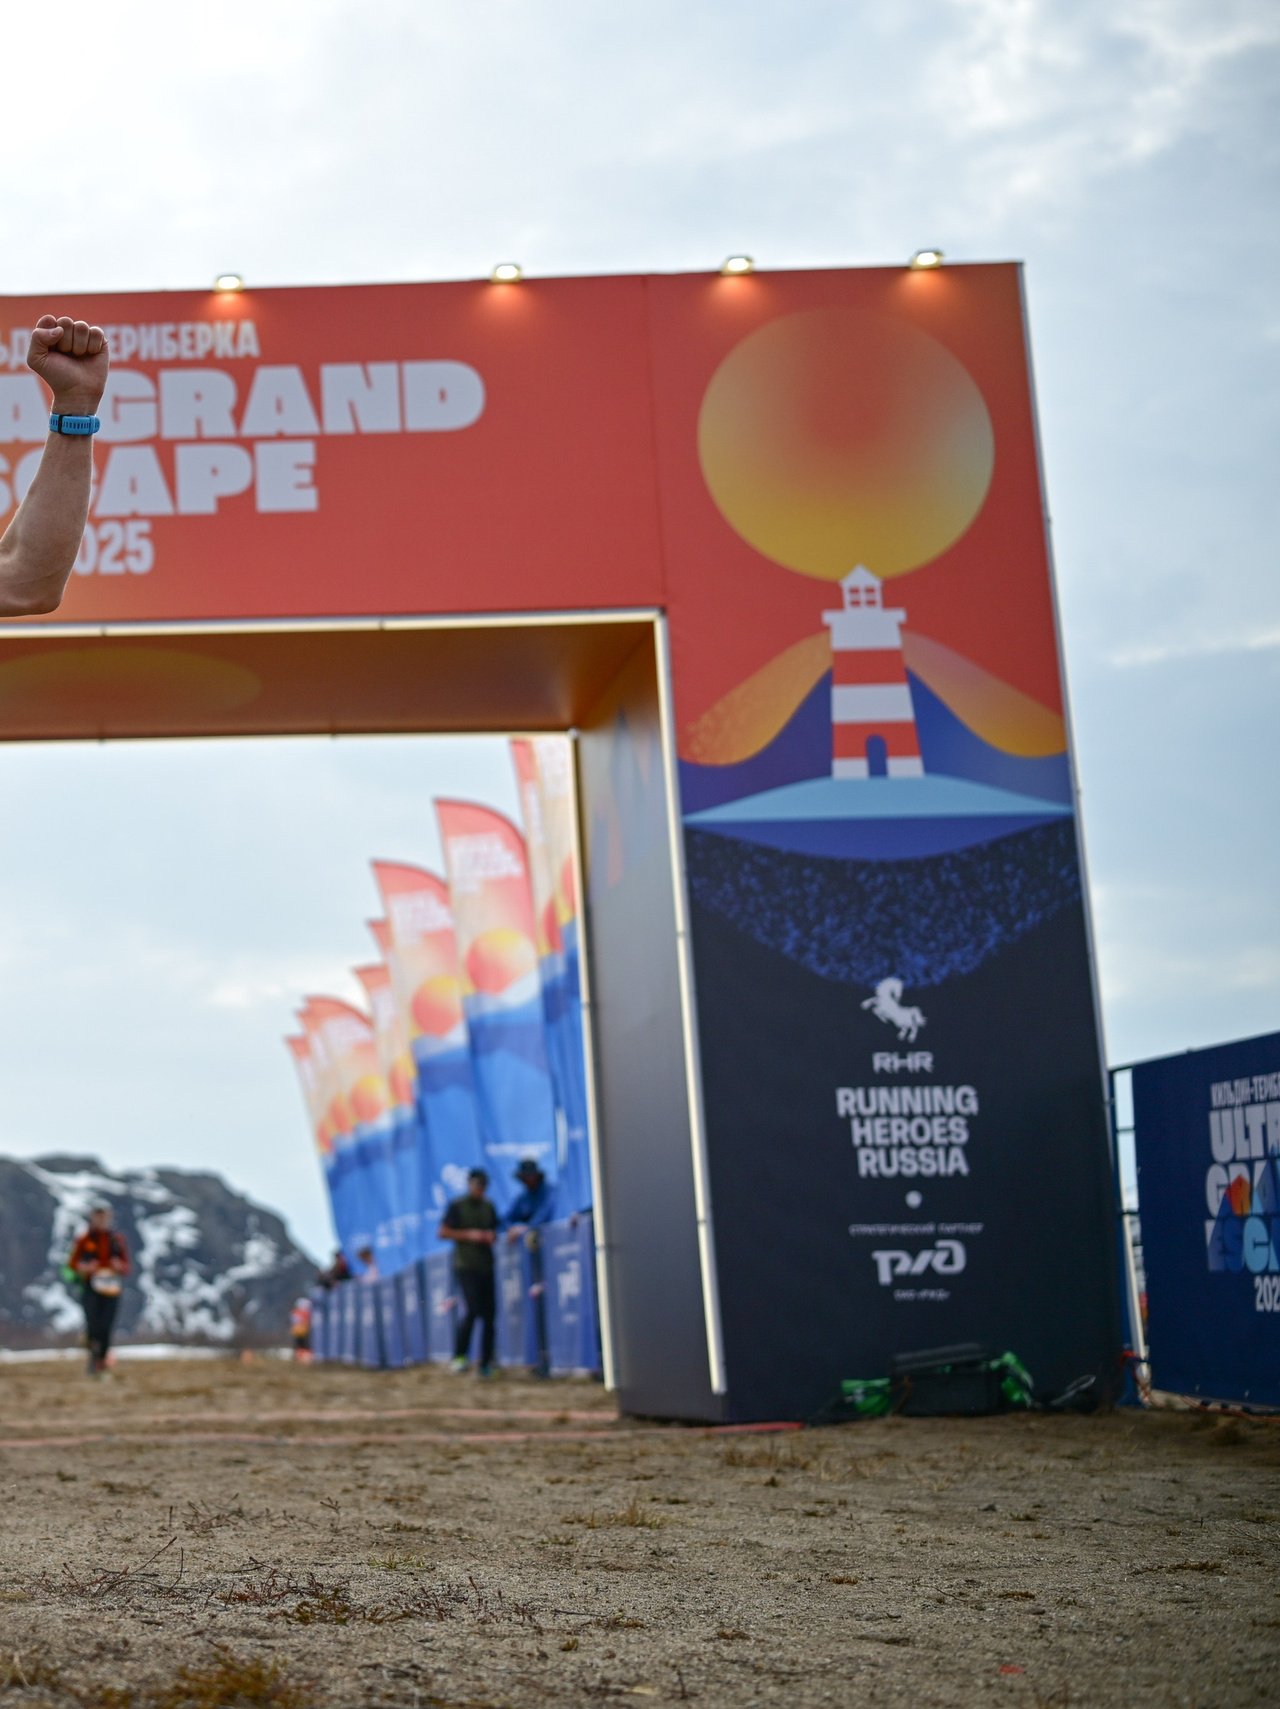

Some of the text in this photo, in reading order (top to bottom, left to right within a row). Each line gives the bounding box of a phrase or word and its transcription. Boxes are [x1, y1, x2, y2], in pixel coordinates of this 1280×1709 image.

[92, 359, 486, 443] GRAND
[71, 519, 154, 576] 025
[872, 1051, 934, 1074] RHR
[835, 1085, 979, 1118] RUNNING
[850, 1115, 970, 1147] HEROES
[857, 1146, 970, 1178] RUSSIA
